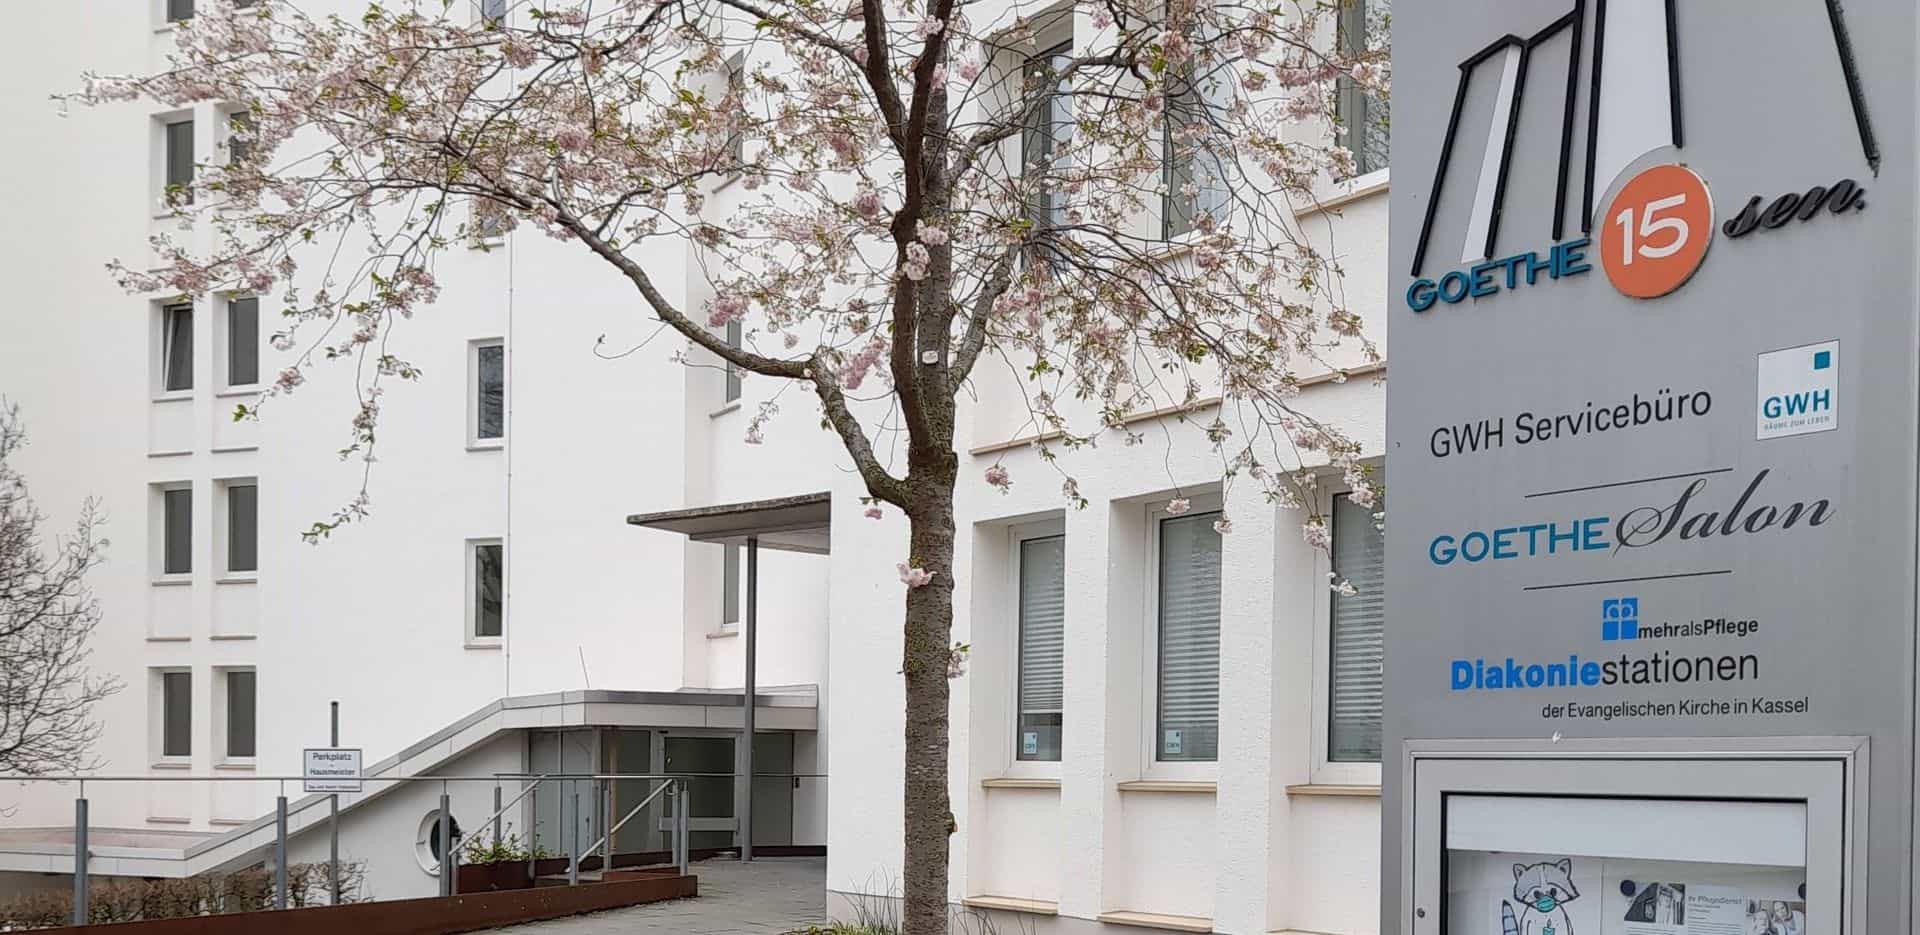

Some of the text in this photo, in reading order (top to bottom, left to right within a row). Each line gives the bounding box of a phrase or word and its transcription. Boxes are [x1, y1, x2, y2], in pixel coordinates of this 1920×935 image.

[1406, 178, 1866, 313] GOETHE 15 sen.
[1430, 387, 1712, 458] GWH Servicebüro
[1763, 388, 1830, 419] GWH
[1429, 468, 1836, 565] GOETHE Salon
[1638, 618, 1759, 638] mehralsPflege
[1450, 650, 1759, 691] Diakoniestationen
[1542, 696, 1809, 721] der Evangelischen Kirche in Kassel
